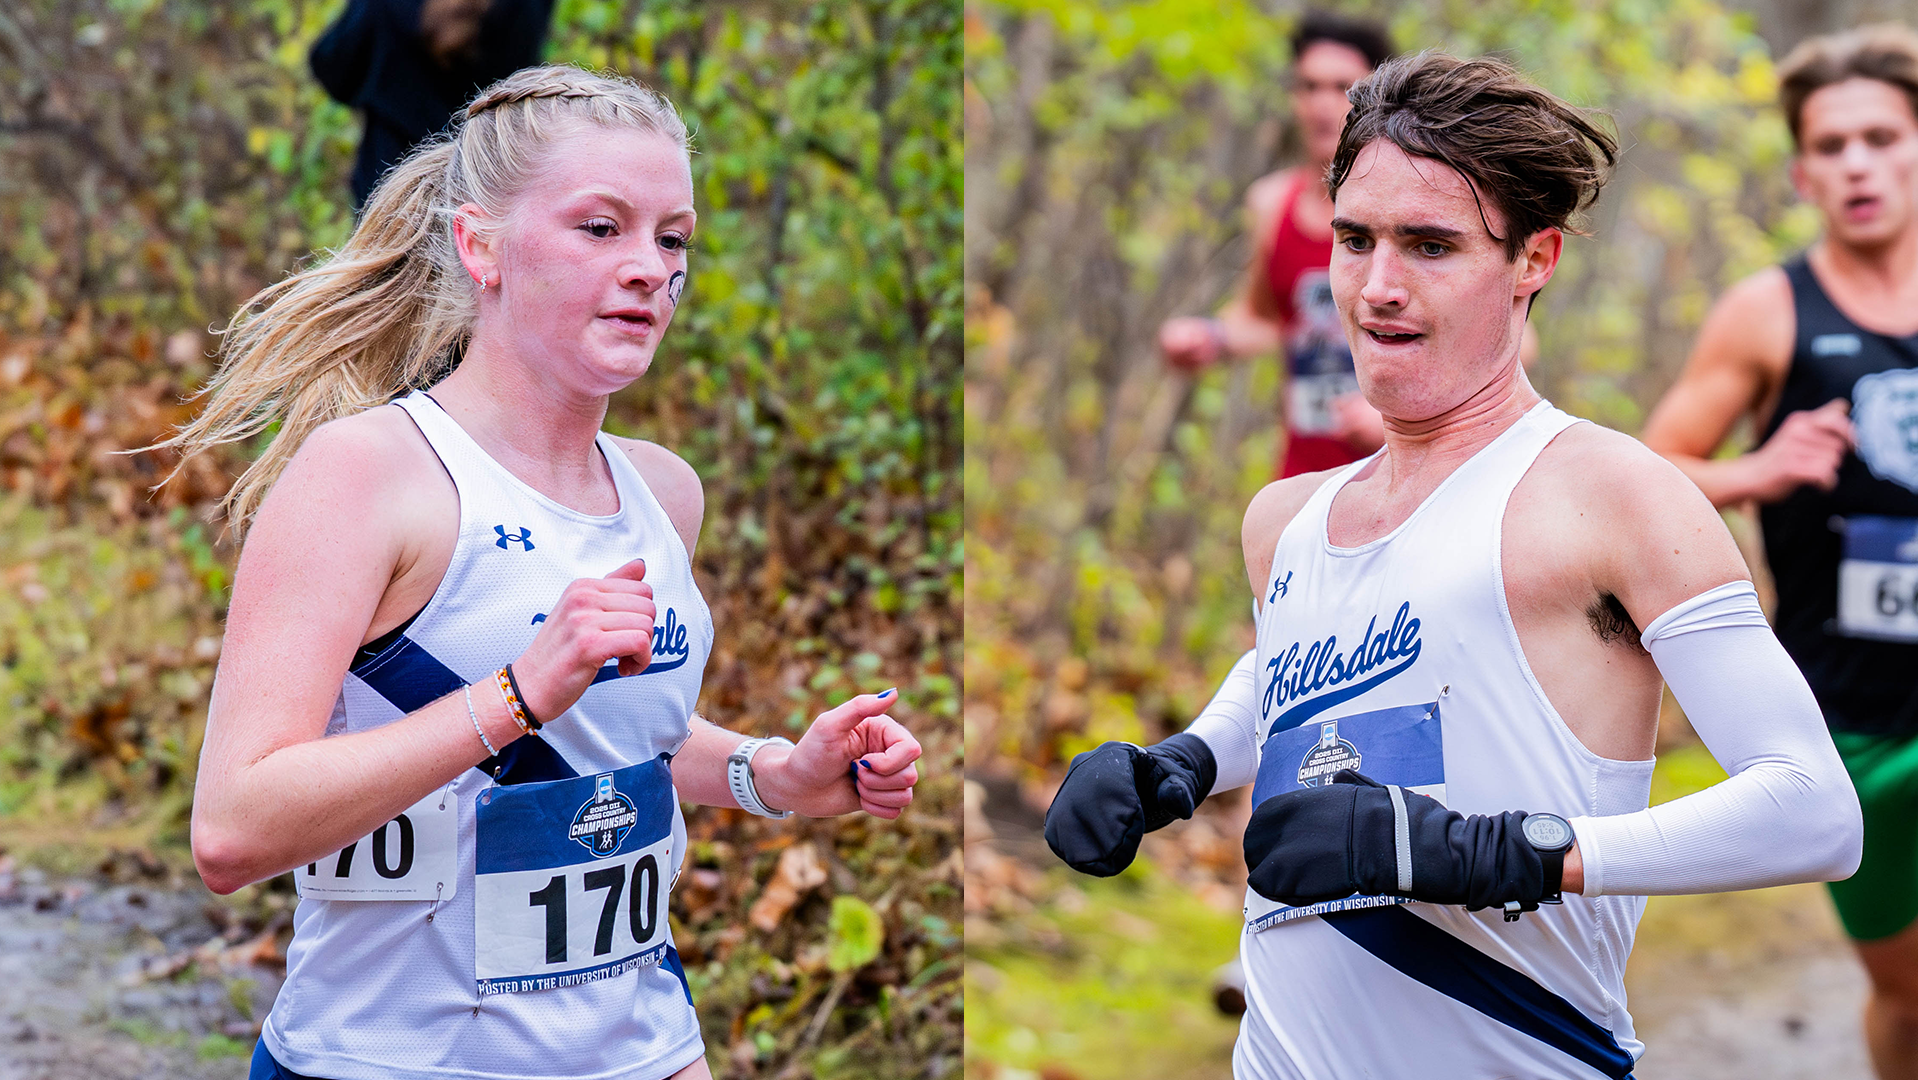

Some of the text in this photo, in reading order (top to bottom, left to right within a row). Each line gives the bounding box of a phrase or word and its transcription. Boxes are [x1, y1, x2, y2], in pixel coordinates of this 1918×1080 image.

[1262, 601, 1422, 721] Hillsdale
[1300, 757, 1359, 780] CHAMPIONSHIPS
[1309, 752, 1349, 766] CROSS COUNTRY
[583, 807, 626, 822] CROSS COUNTRY
[589, 805, 608, 814] 2025
[571, 812, 636, 836] CHAMPIONSHIPS
[529, 854, 659, 965] 170
[1286, 902, 1328, 920] UNIVERSITY
[1330, 900, 1342, 912] OF
[1344, 896, 1396, 910] WISCONSIN
[478, 981, 518, 995] HOSTED
[521, 980, 535, 992] BY
[537, 977, 556, 990] THE
[559, 967, 610, 987] UNIVERSITY
[611, 964, 621, 977] OF
[622, 951, 655, 972] WISCONSIN
